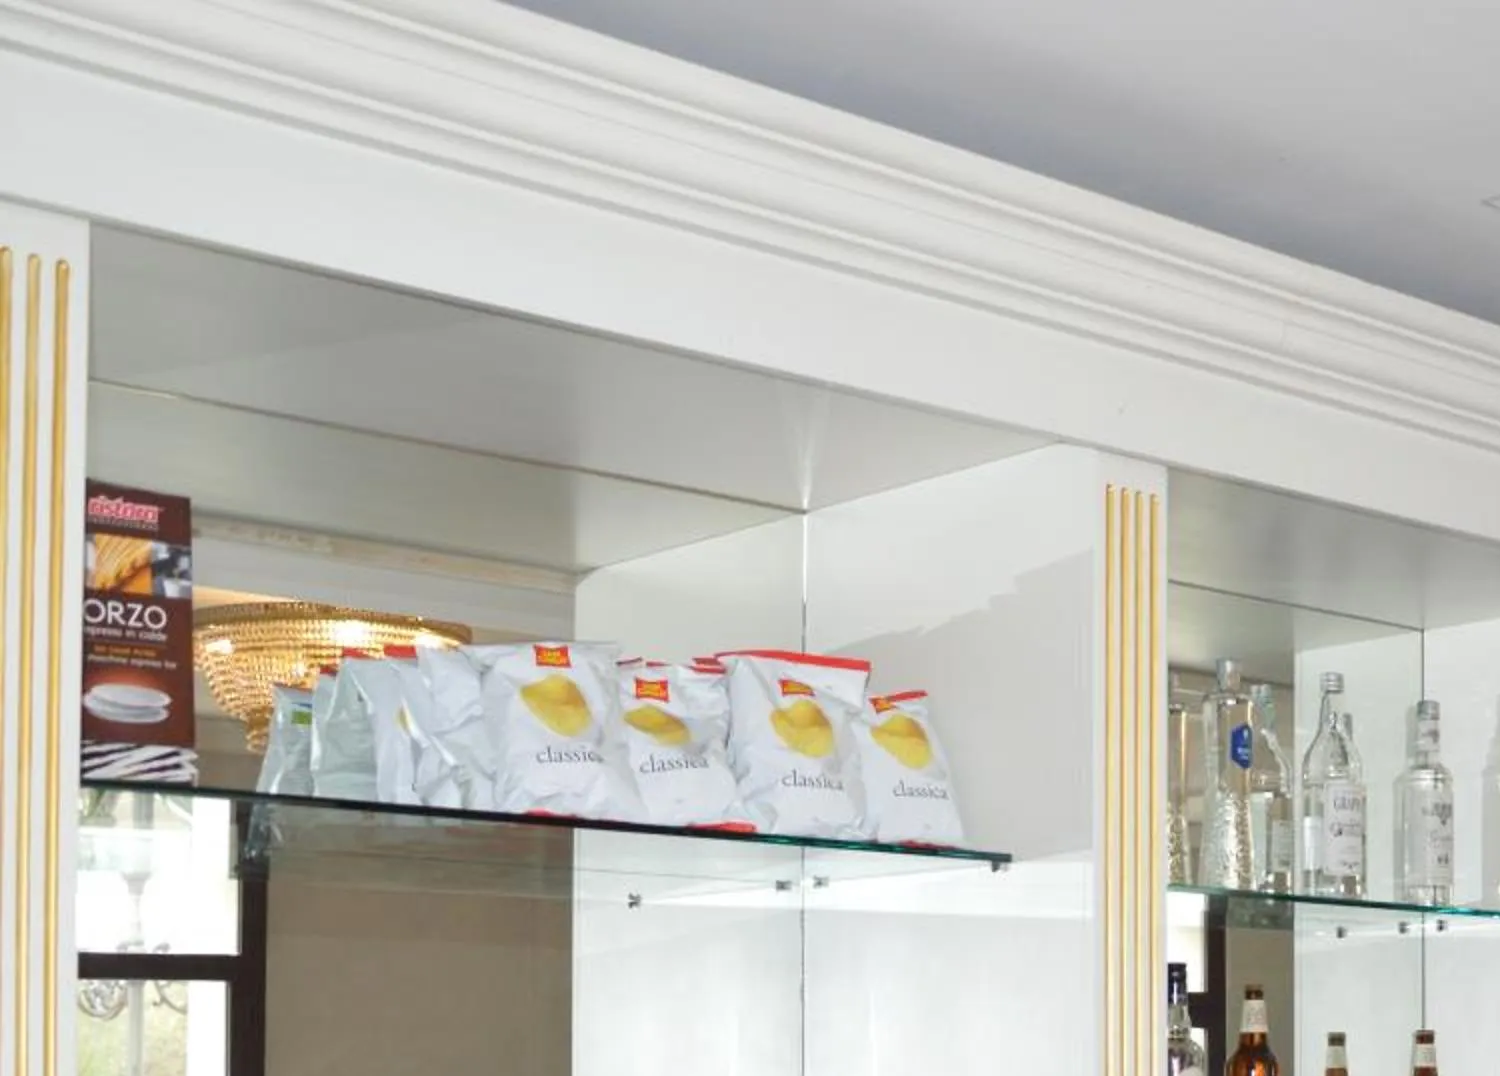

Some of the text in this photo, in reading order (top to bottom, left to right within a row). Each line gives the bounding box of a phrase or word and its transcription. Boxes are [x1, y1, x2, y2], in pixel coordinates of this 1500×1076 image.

[82, 598, 167, 629] ORZO
[781, 768, 844, 792] classica
[892, 780, 950, 800] classica
